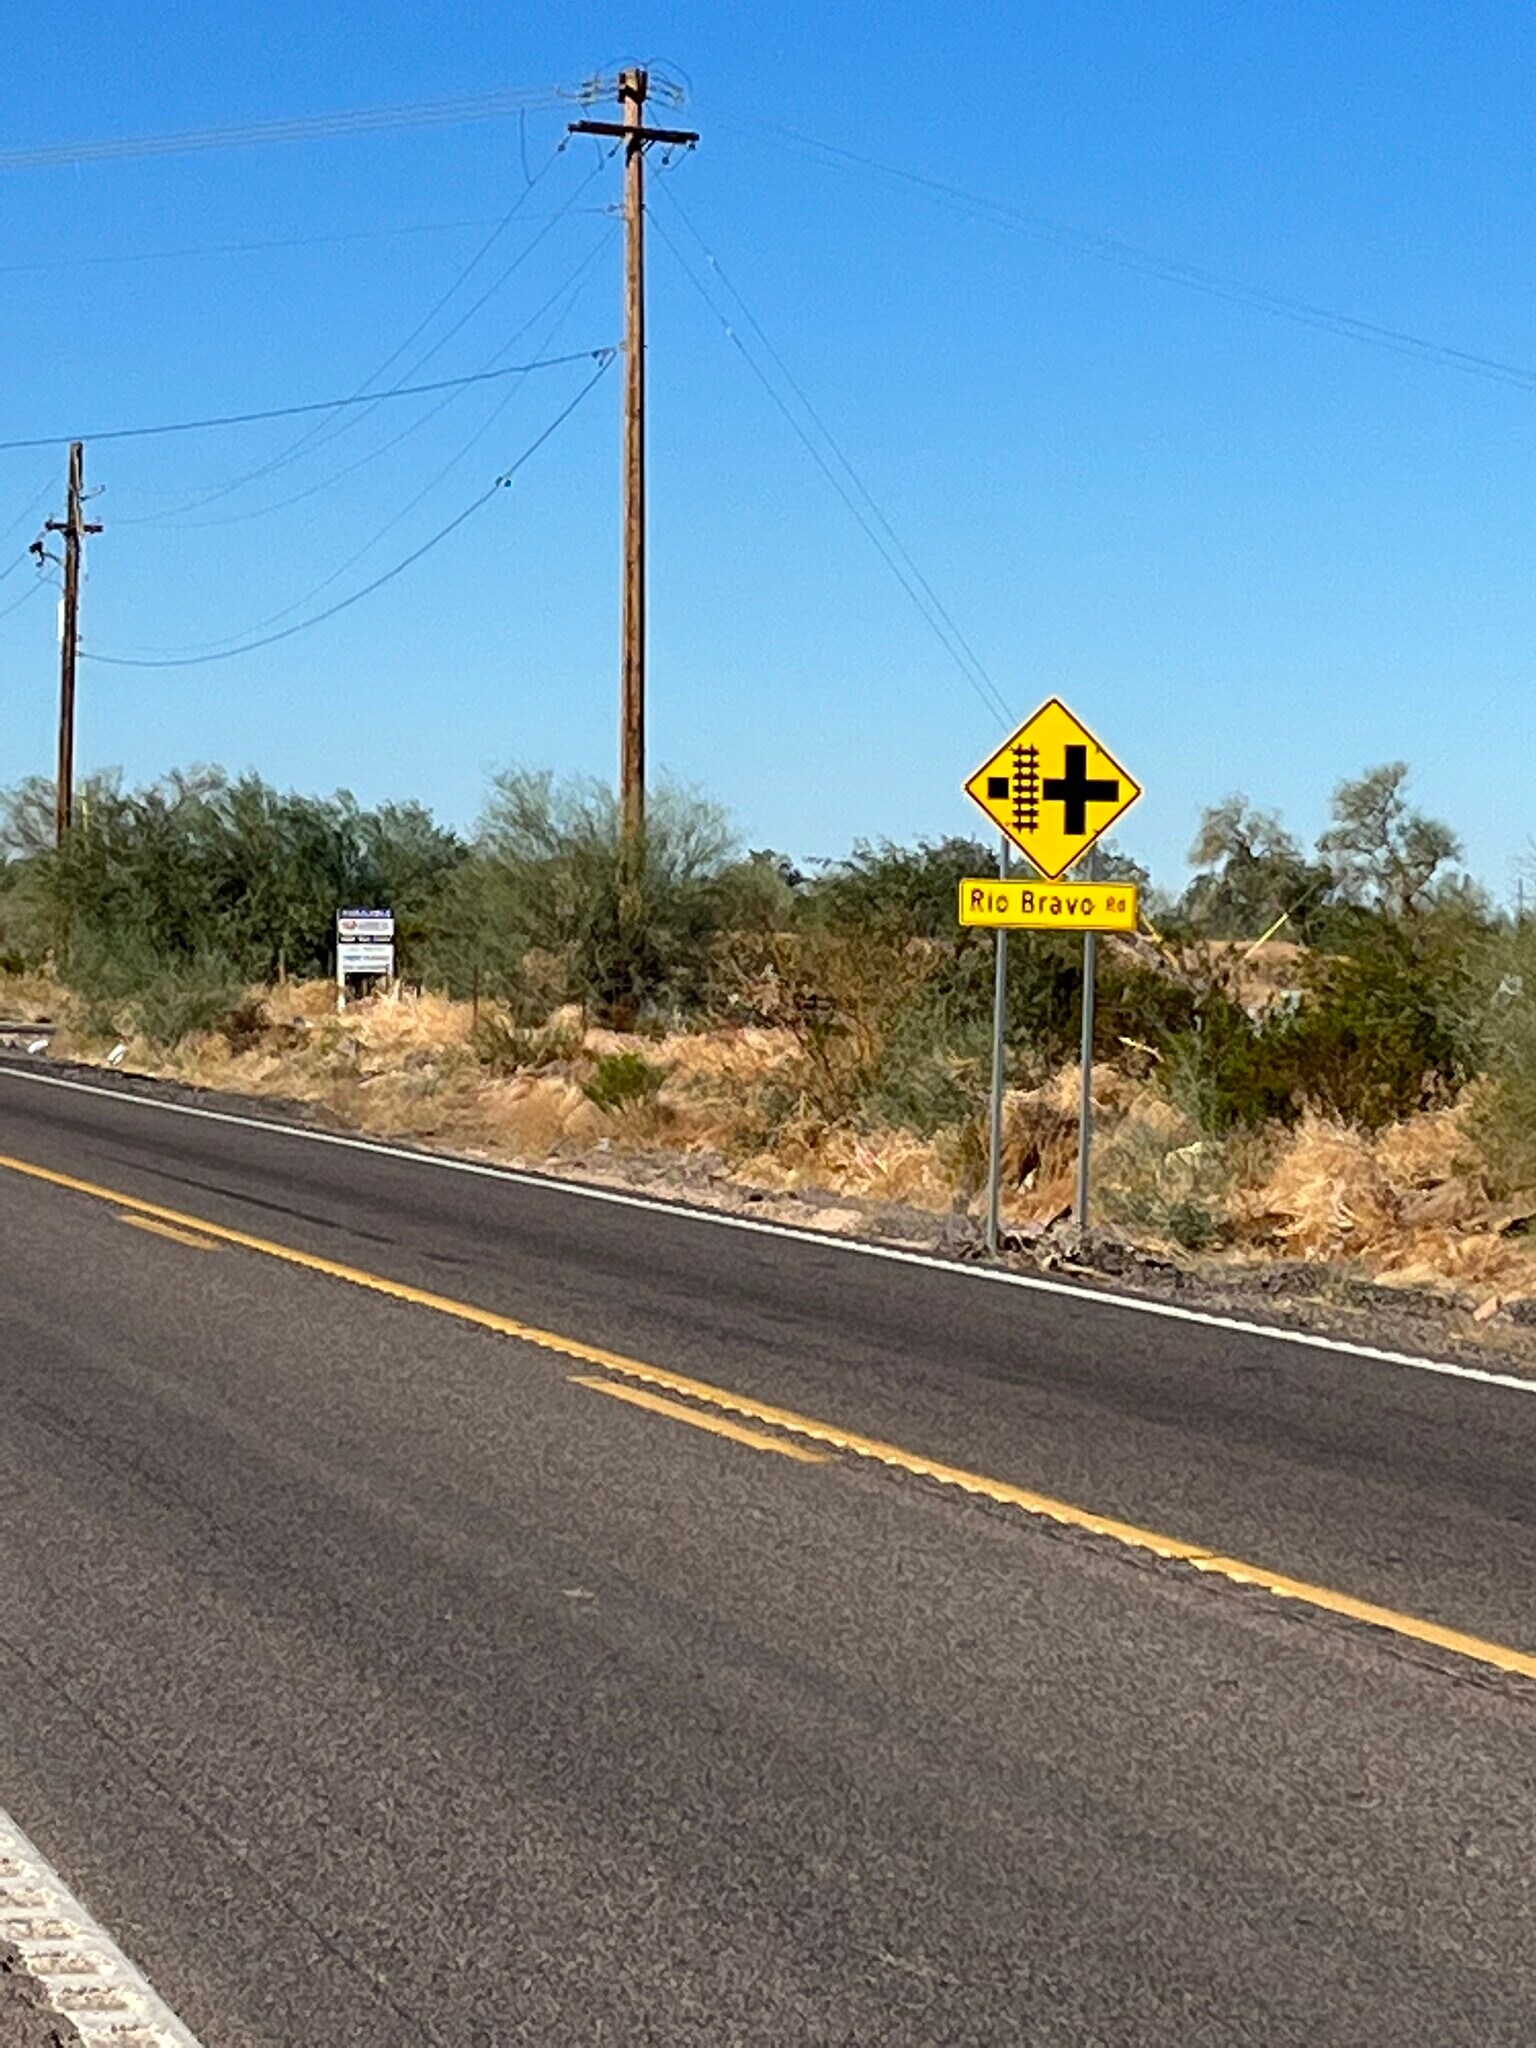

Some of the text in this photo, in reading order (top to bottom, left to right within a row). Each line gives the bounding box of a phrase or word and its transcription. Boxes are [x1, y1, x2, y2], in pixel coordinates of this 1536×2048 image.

[970, 888, 1126, 915] Rio Bravo Rd
